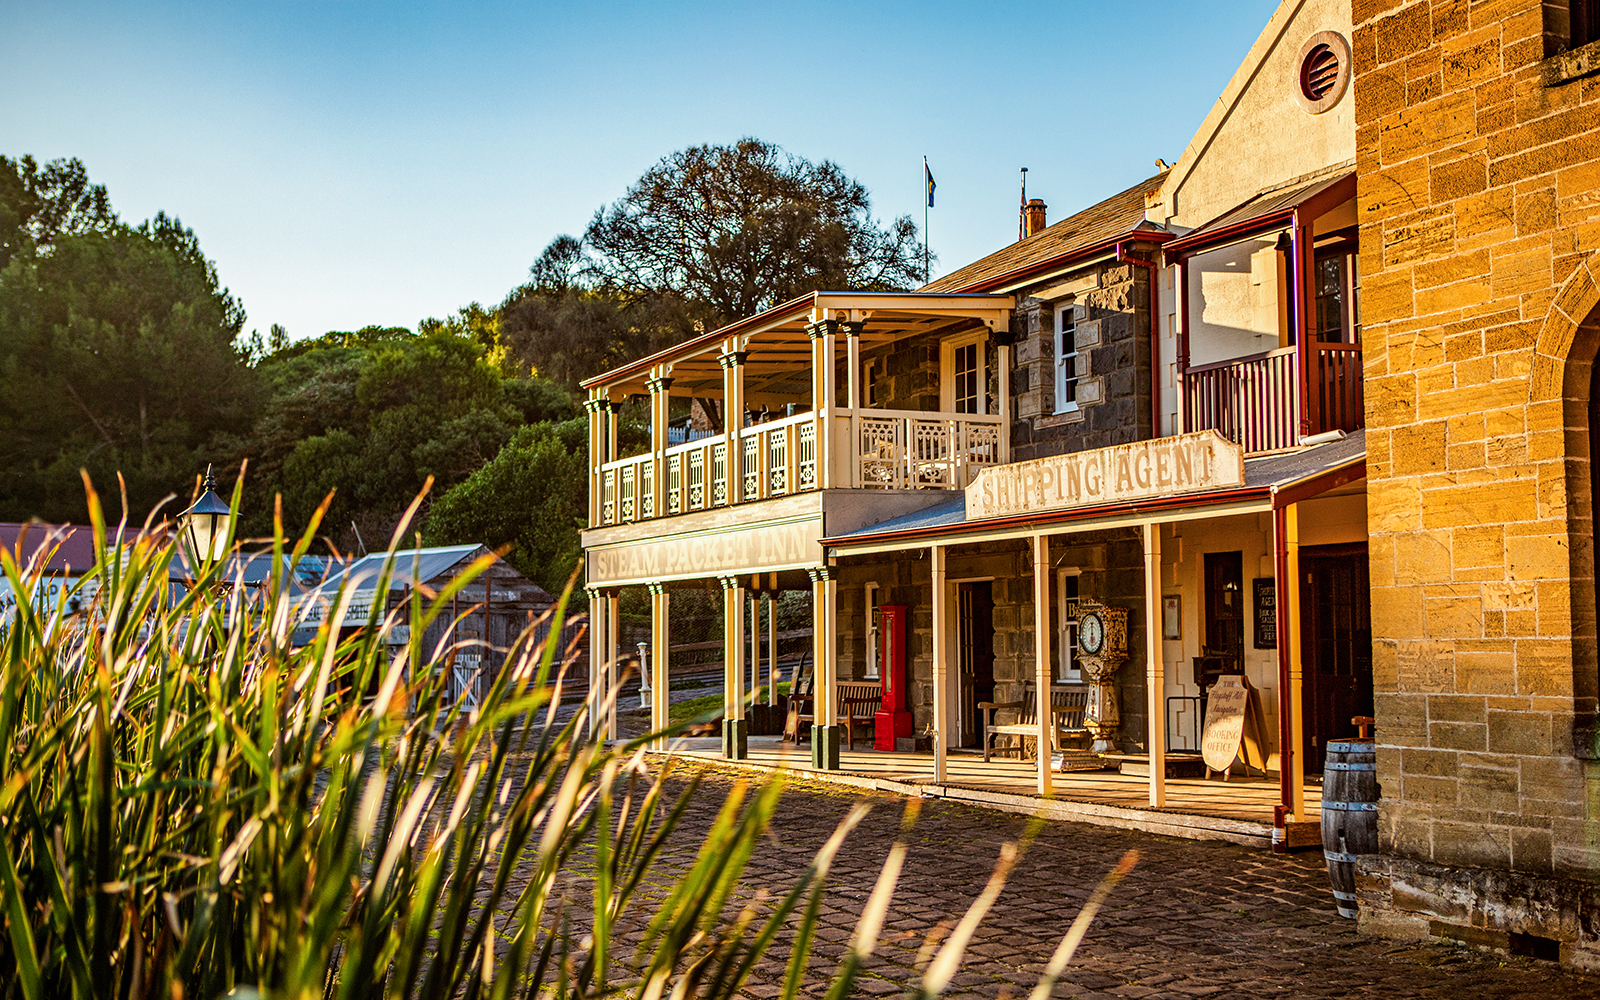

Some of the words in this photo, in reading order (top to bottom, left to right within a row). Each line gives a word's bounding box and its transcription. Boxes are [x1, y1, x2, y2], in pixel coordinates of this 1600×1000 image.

[982, 456, 1101, 509] SHIPPING
[1115, 440, 1214, 493] AGENT
[597, 541, 660, 579] STEAM
[665, 531, 753, 574] PACKET
[758, 524, 809, 564] INN
[1223, 680, 1235, 688] THE
[1206, 729, 1239, 741] BOOKING
[1207, 741, 1233, 753] OFFICE
